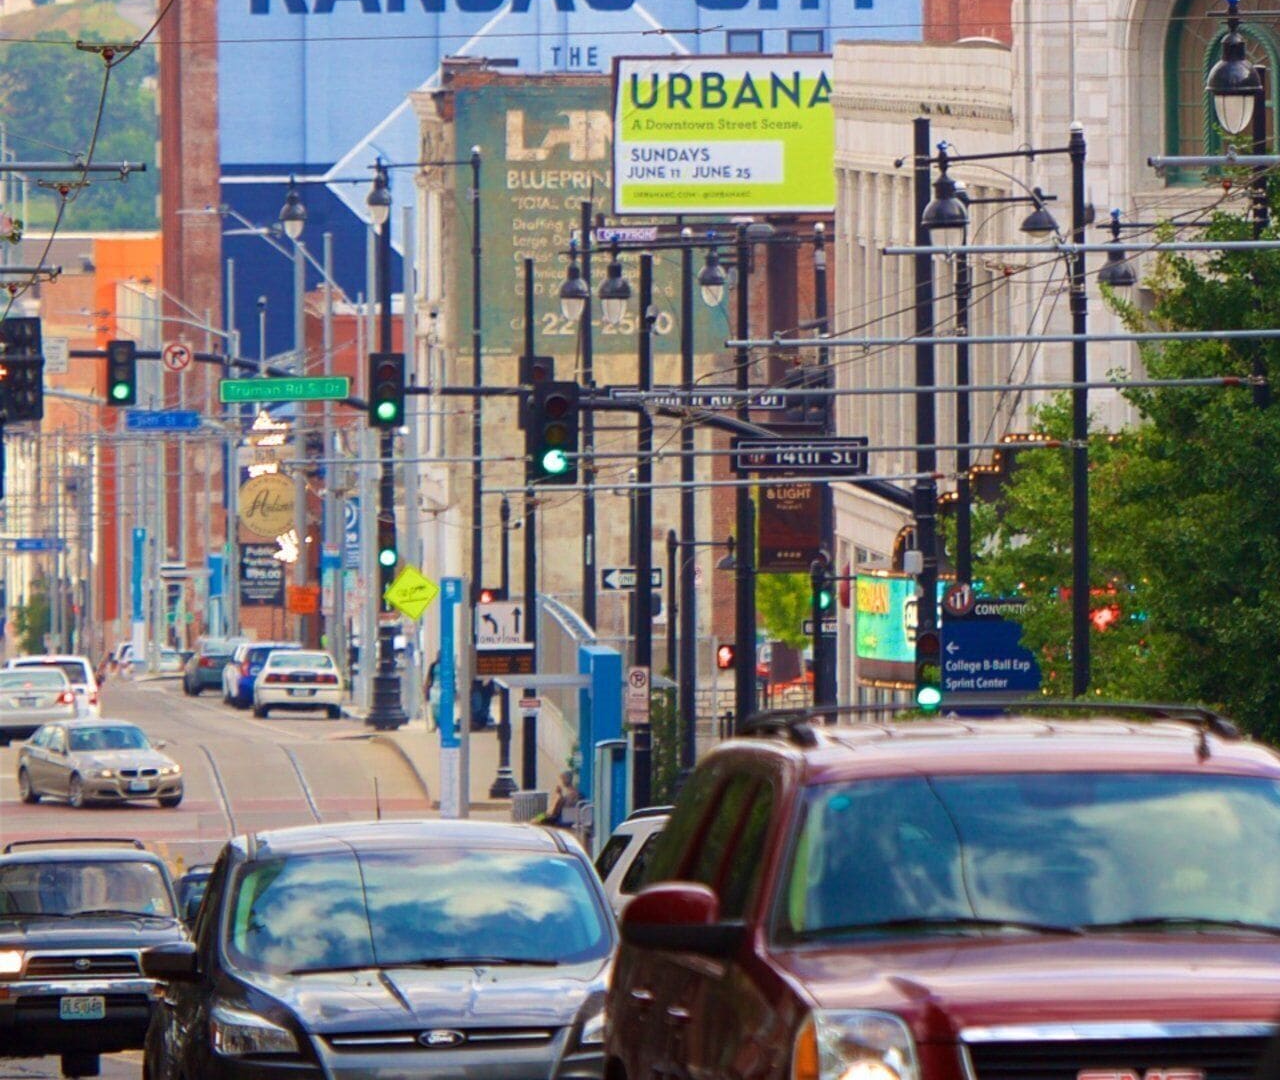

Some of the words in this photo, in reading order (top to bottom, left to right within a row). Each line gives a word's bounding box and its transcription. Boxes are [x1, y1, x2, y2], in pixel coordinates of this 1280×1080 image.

[550, 46, 597, 66] THE
[631, 71, 832, 109] URBANA
[631, 121, 642, 131] A
[646, 120, 714, 131] Downtown
[718, 119, 758, 130] Street
[761, 119, 802, 130] Scene.
[631, 149, 711, 162] SUNDAYS
[626, 167, 665, 179] JUNE
[692, 166, 731, 178] JUNE
[736, 168, 751, 179] 25
[229, 384, 282, 397] Truman
[286, 383, 303, 395] Rd
[776, 446, 821, 463] 14th
[831, 446, 852, 463] St
[777, 488, 811, 499] LIGHT
[946, 660, 981, 673] College
[983, 660, 1010, 671] B-Ball
[1012, 660, 1030, 673] Exp
[946, 677, 974, 690] Sprint
[977, 678, 1008, 689] Center
